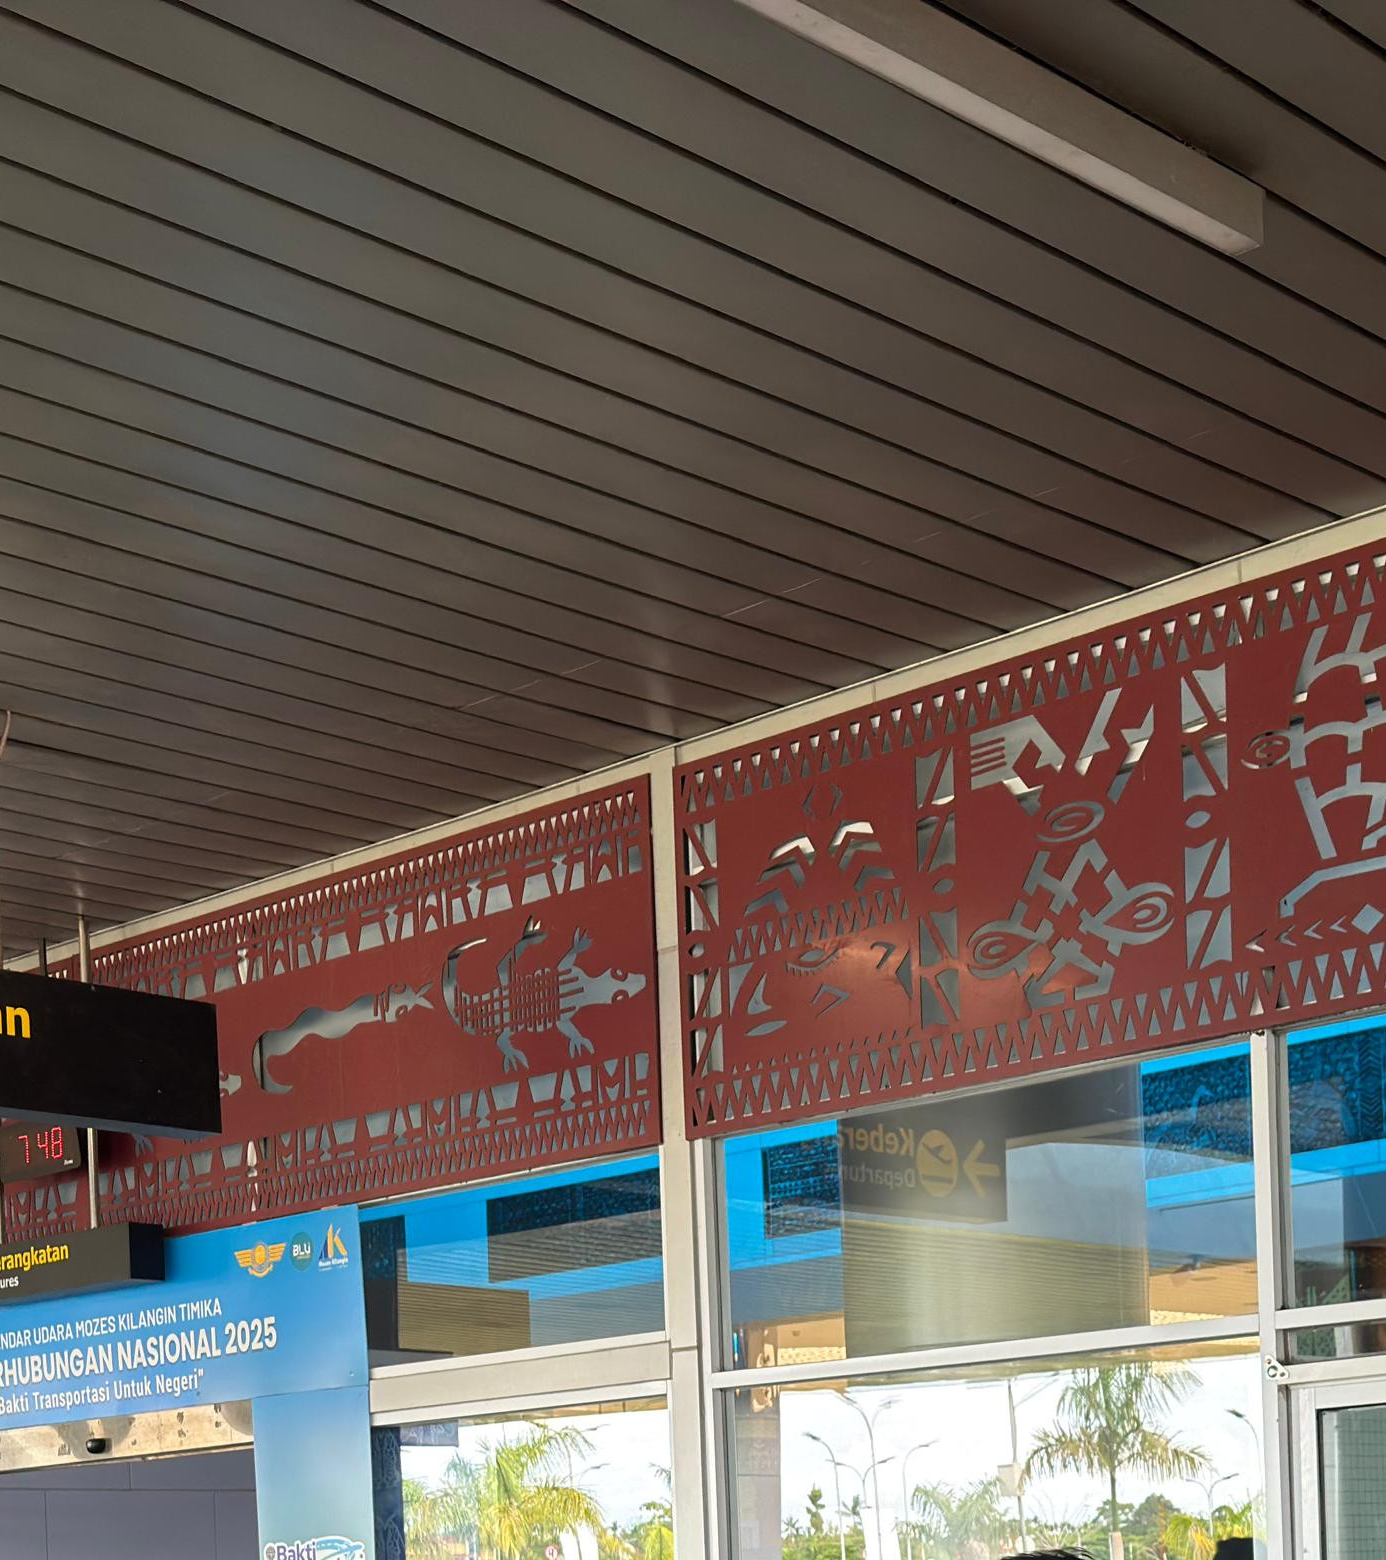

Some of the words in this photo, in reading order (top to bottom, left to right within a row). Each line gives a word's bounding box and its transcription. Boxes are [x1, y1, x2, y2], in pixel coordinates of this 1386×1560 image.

[293, 1242, 310, 1256] BLU
[33, 1322, 73, 1345] UDARA
[76, 1316, 116, 1338] MOZES
[118, 1305, 177, 1332] KILANGIN
[179, 1297, 222, 1321] TIMIKA
[117, 1327, 221, 1370] NASIONAL
[224, 1316, 277, 1354] 2025
[32, 1380, 110, 1411] Transportasi
[114, 1375, 152, 1400] Untuk
